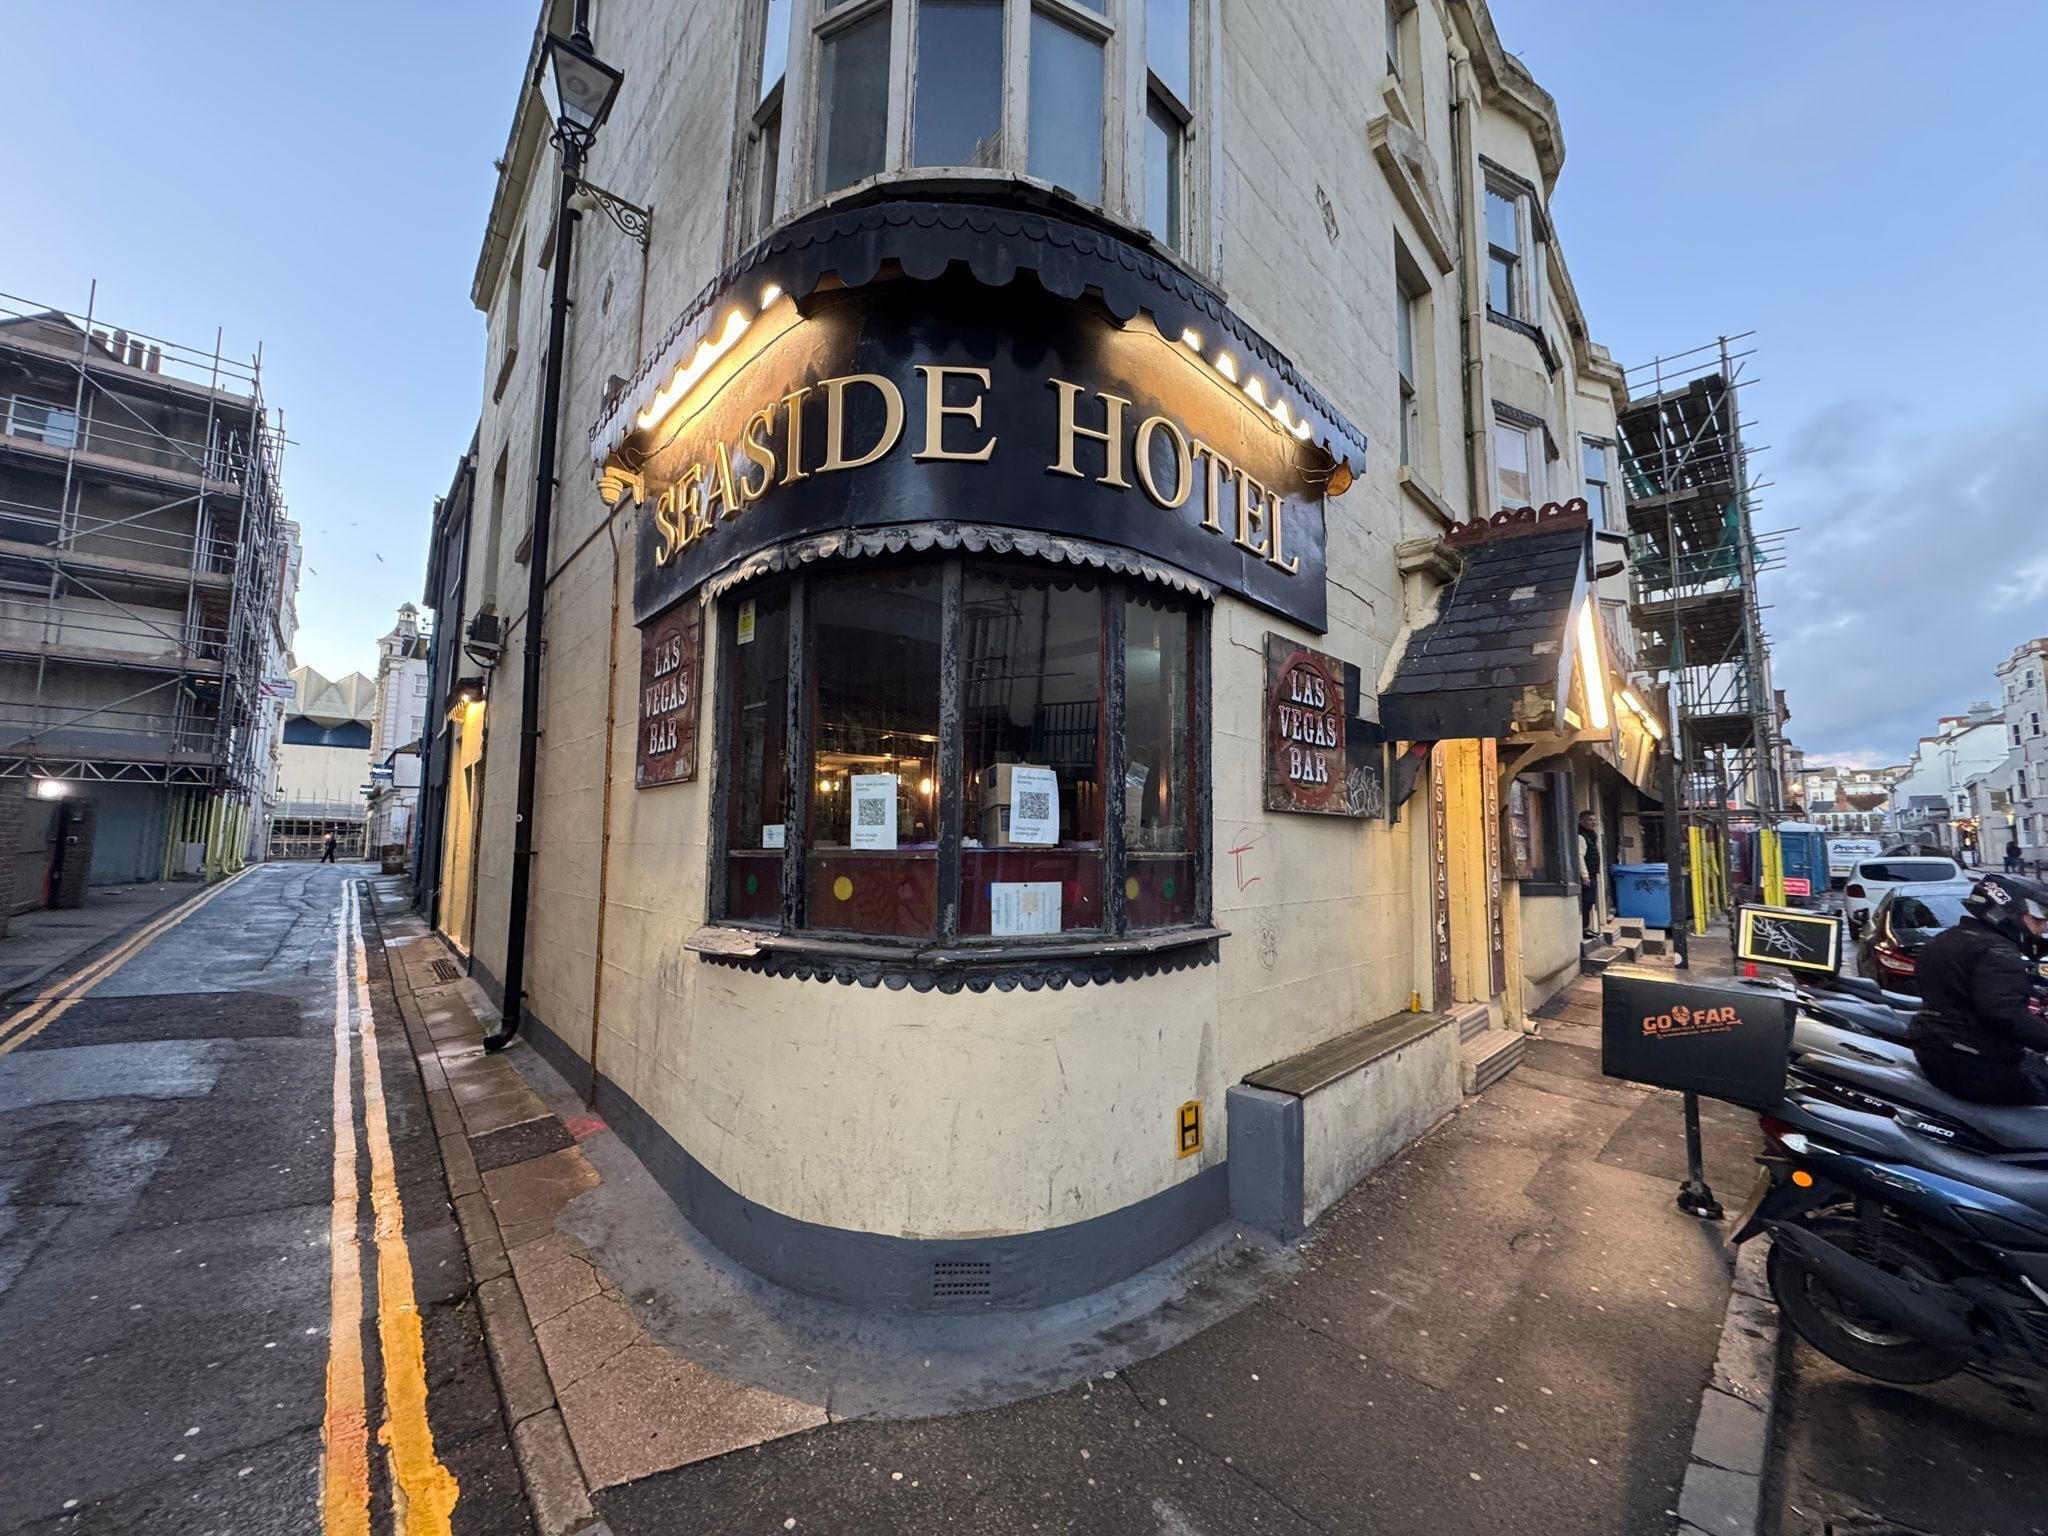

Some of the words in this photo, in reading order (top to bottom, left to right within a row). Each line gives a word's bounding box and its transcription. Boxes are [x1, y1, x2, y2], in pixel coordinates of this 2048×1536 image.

[655, 365, 997, 568] SEASIDE
[1047, 377, 1299, 575] HOTEL
[653, 635, 681, 678] LAS
[645, 672, 689, 718] VEGAS
[1290, 669, 1326, 708] LAS
[648, 717, 678, 755] BAR
[1278, 704, 1337, 748] VEGAS
[1288, 747, 1329, 784] BAR
[1435, 750, 1443, 802] LAS
[1436, 811, 1445, 900] VEGAS
[1643, 1015, 1672, 1031] GO
[1692, 1007, 1737, 1025] FAR
[1181, 1105, 1199, 1151] H
[1918, 1122, 1955, 1138] neco
